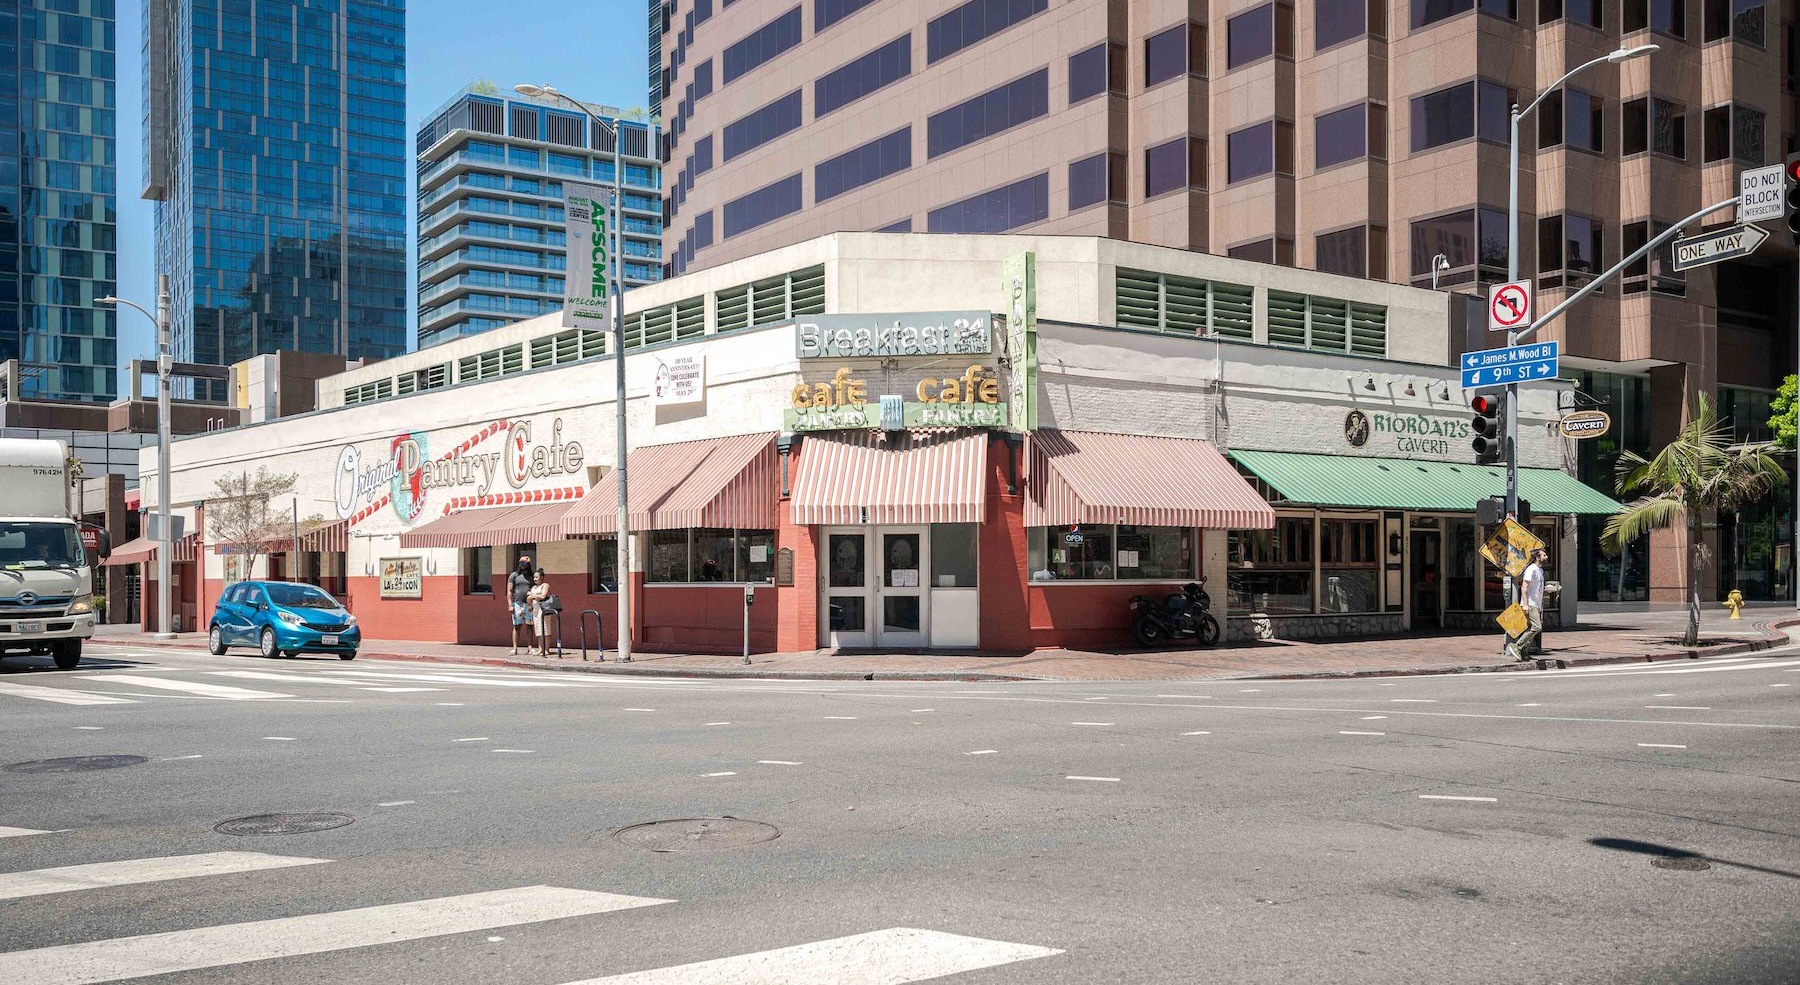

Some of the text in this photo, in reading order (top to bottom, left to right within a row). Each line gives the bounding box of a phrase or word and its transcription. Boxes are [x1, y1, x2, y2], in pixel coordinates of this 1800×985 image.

[1744, 172, 1781, 190] DO NOT
[1745, 190, 1779, 206] BLOCK
[1745, 204, 1781, 217] INTERSECTION
[591, 199, 606, 299] AFSCME
[1680, 234, 1742, 261] ONE WAY
[568, 297, 608, 309] WELCOME
[799, 318, 986, 356] Breakfast 24
[1481, 354, 1507, 366] James
[1519, 348, 1540, 361] Wood
[1493, 366, 1532, 381] 9th ST
[792, 367, 868, 409] cafe
[917, 365, 999, 405] cafe
[335, 417, 584, 521] Original Pantry Cafe
[80, 531, 96, 541] ADA
[1066, 535, 1083, 543] OPEN
[1054, 552, 1061, 561] A
[395, 577, 403, 587] 24
[403, 579, 418, 590] ICON
